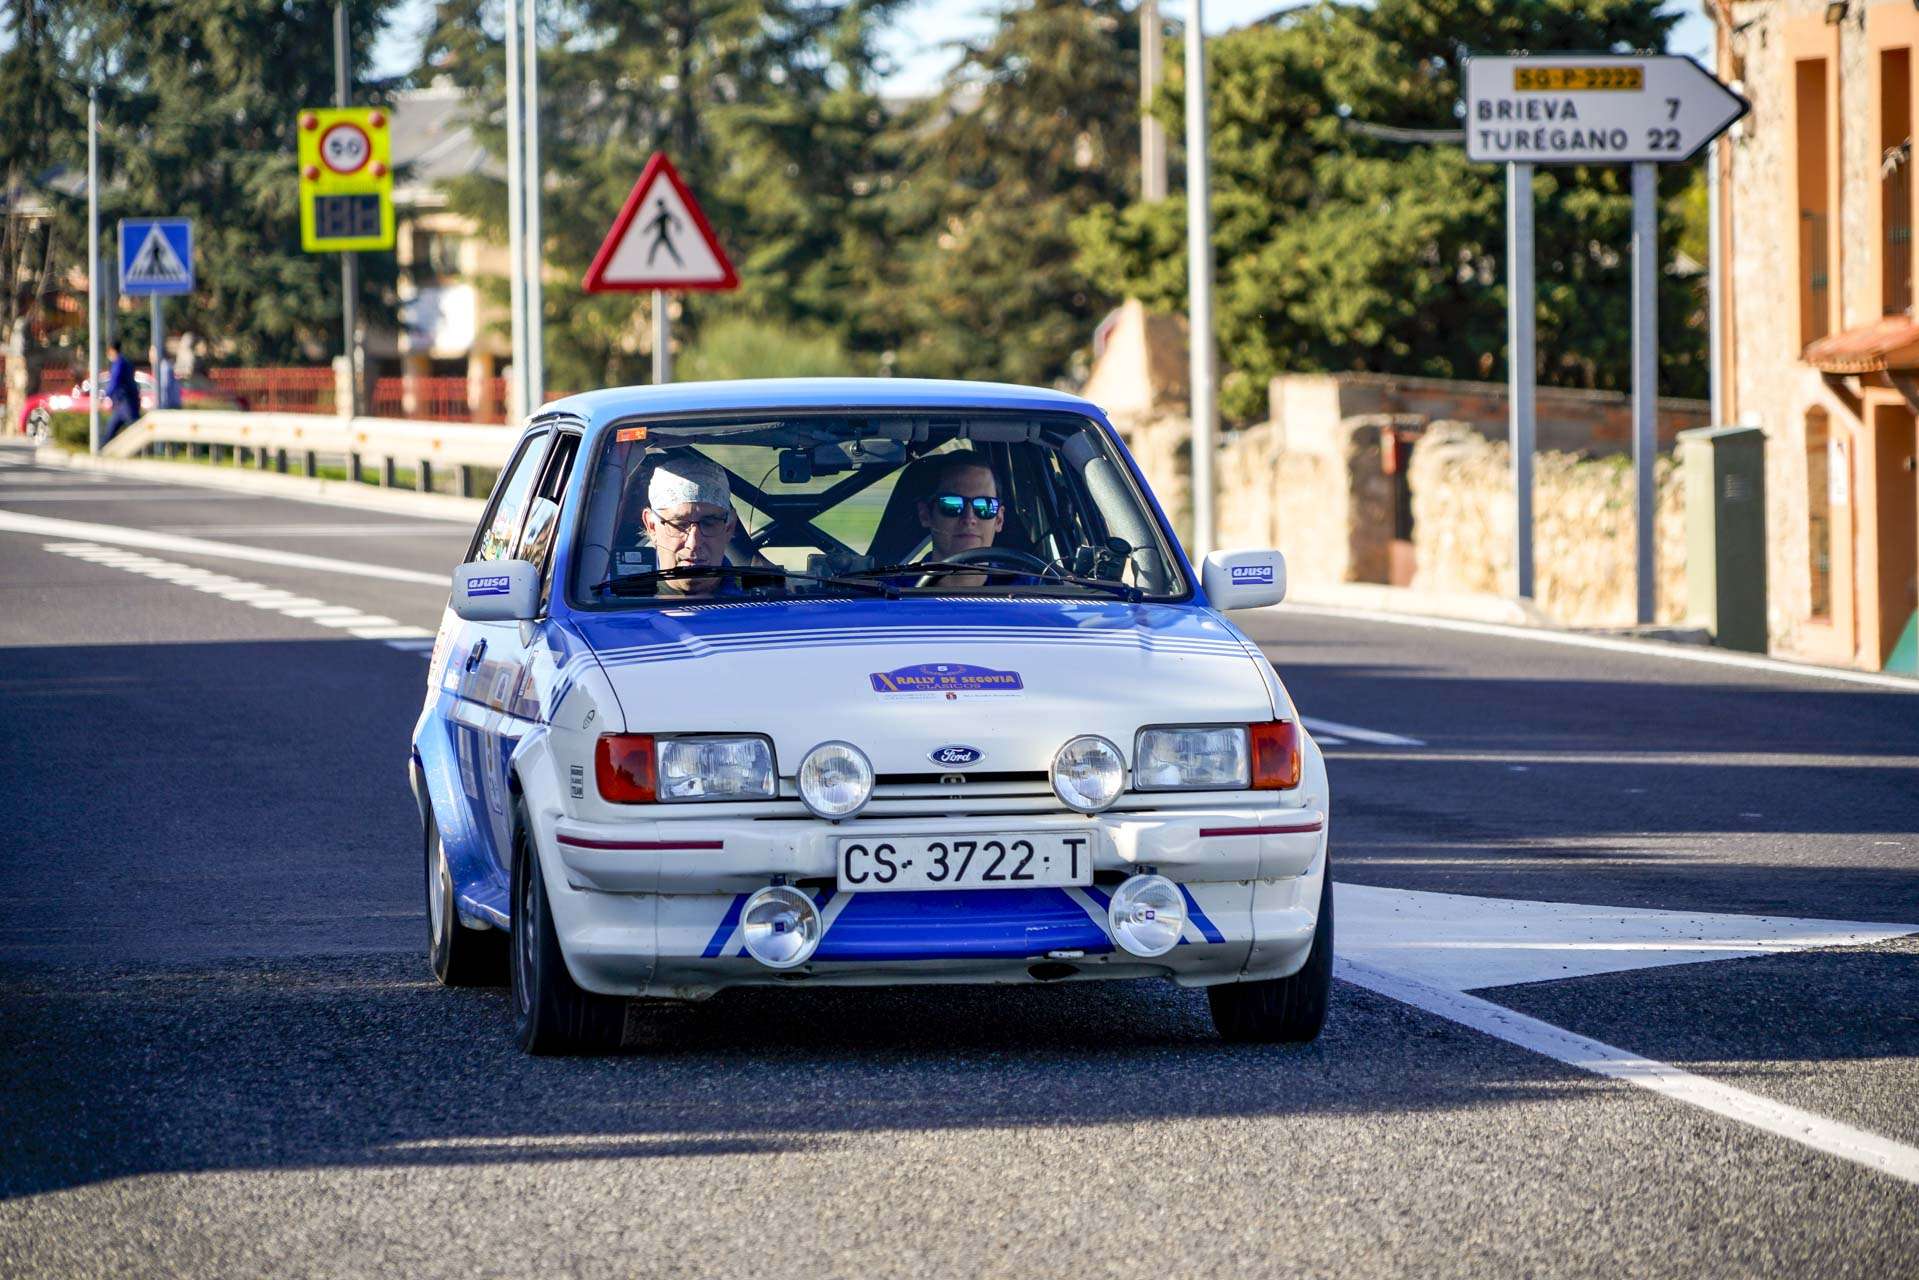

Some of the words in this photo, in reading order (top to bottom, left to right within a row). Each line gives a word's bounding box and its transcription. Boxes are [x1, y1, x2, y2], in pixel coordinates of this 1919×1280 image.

[1477, 99, 1578, 121] BRIEVA
[1664, 98, 1681, 120] 7
[330, 138, 362, 156] 50
[1479, 127, 1628, 152] TURÉGANO
[1647, 128, 1682, 151] 22
[896, 676, 936, 685] RALLY
[941, 676, 958, 684] DE
[962, 675, 1016, 684] SEGOVIA
[940, 748, 972, 762] Ford
